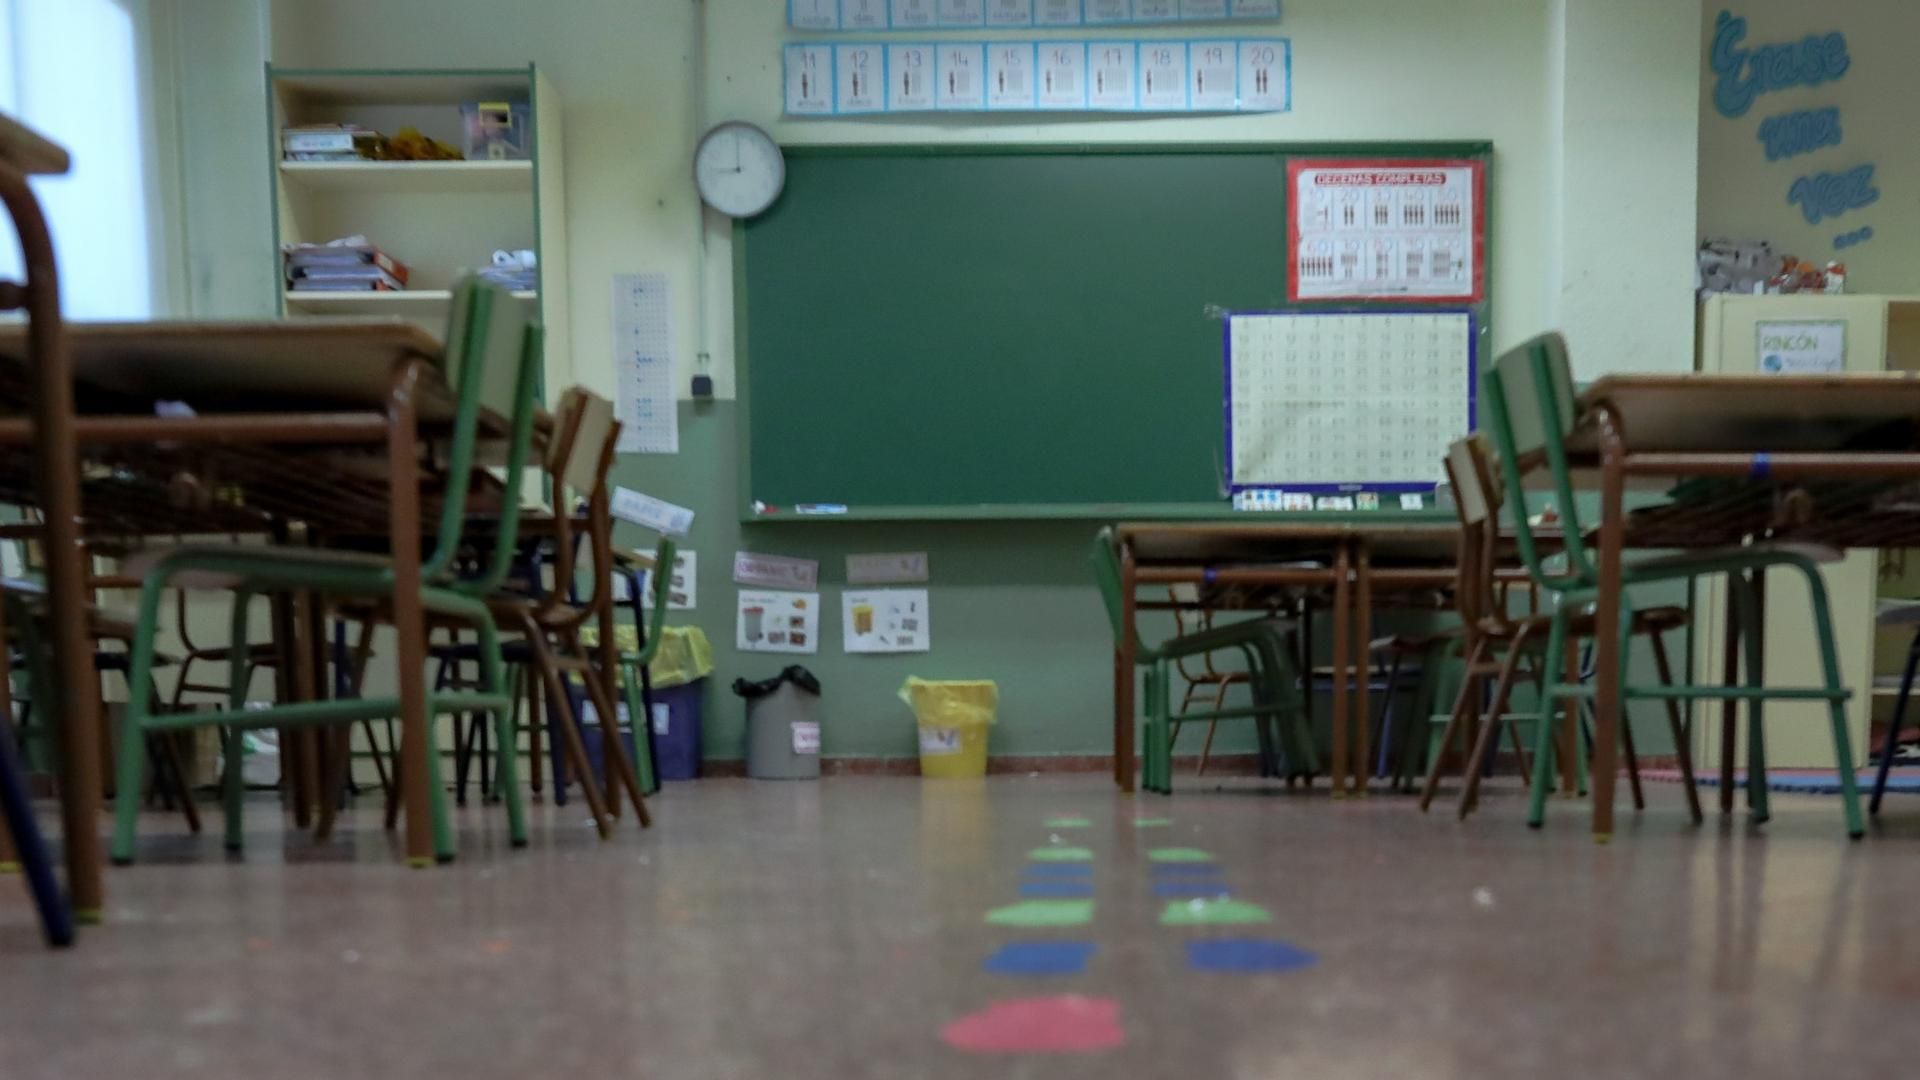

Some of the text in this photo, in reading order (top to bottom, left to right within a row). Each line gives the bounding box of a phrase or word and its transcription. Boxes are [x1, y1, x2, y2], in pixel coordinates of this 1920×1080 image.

[801, 46, 1275, 70] 11 12 13 14 15 16 17 18 19 20
[1316, 173, 1443, 185] DECENAS COMPLETAS
